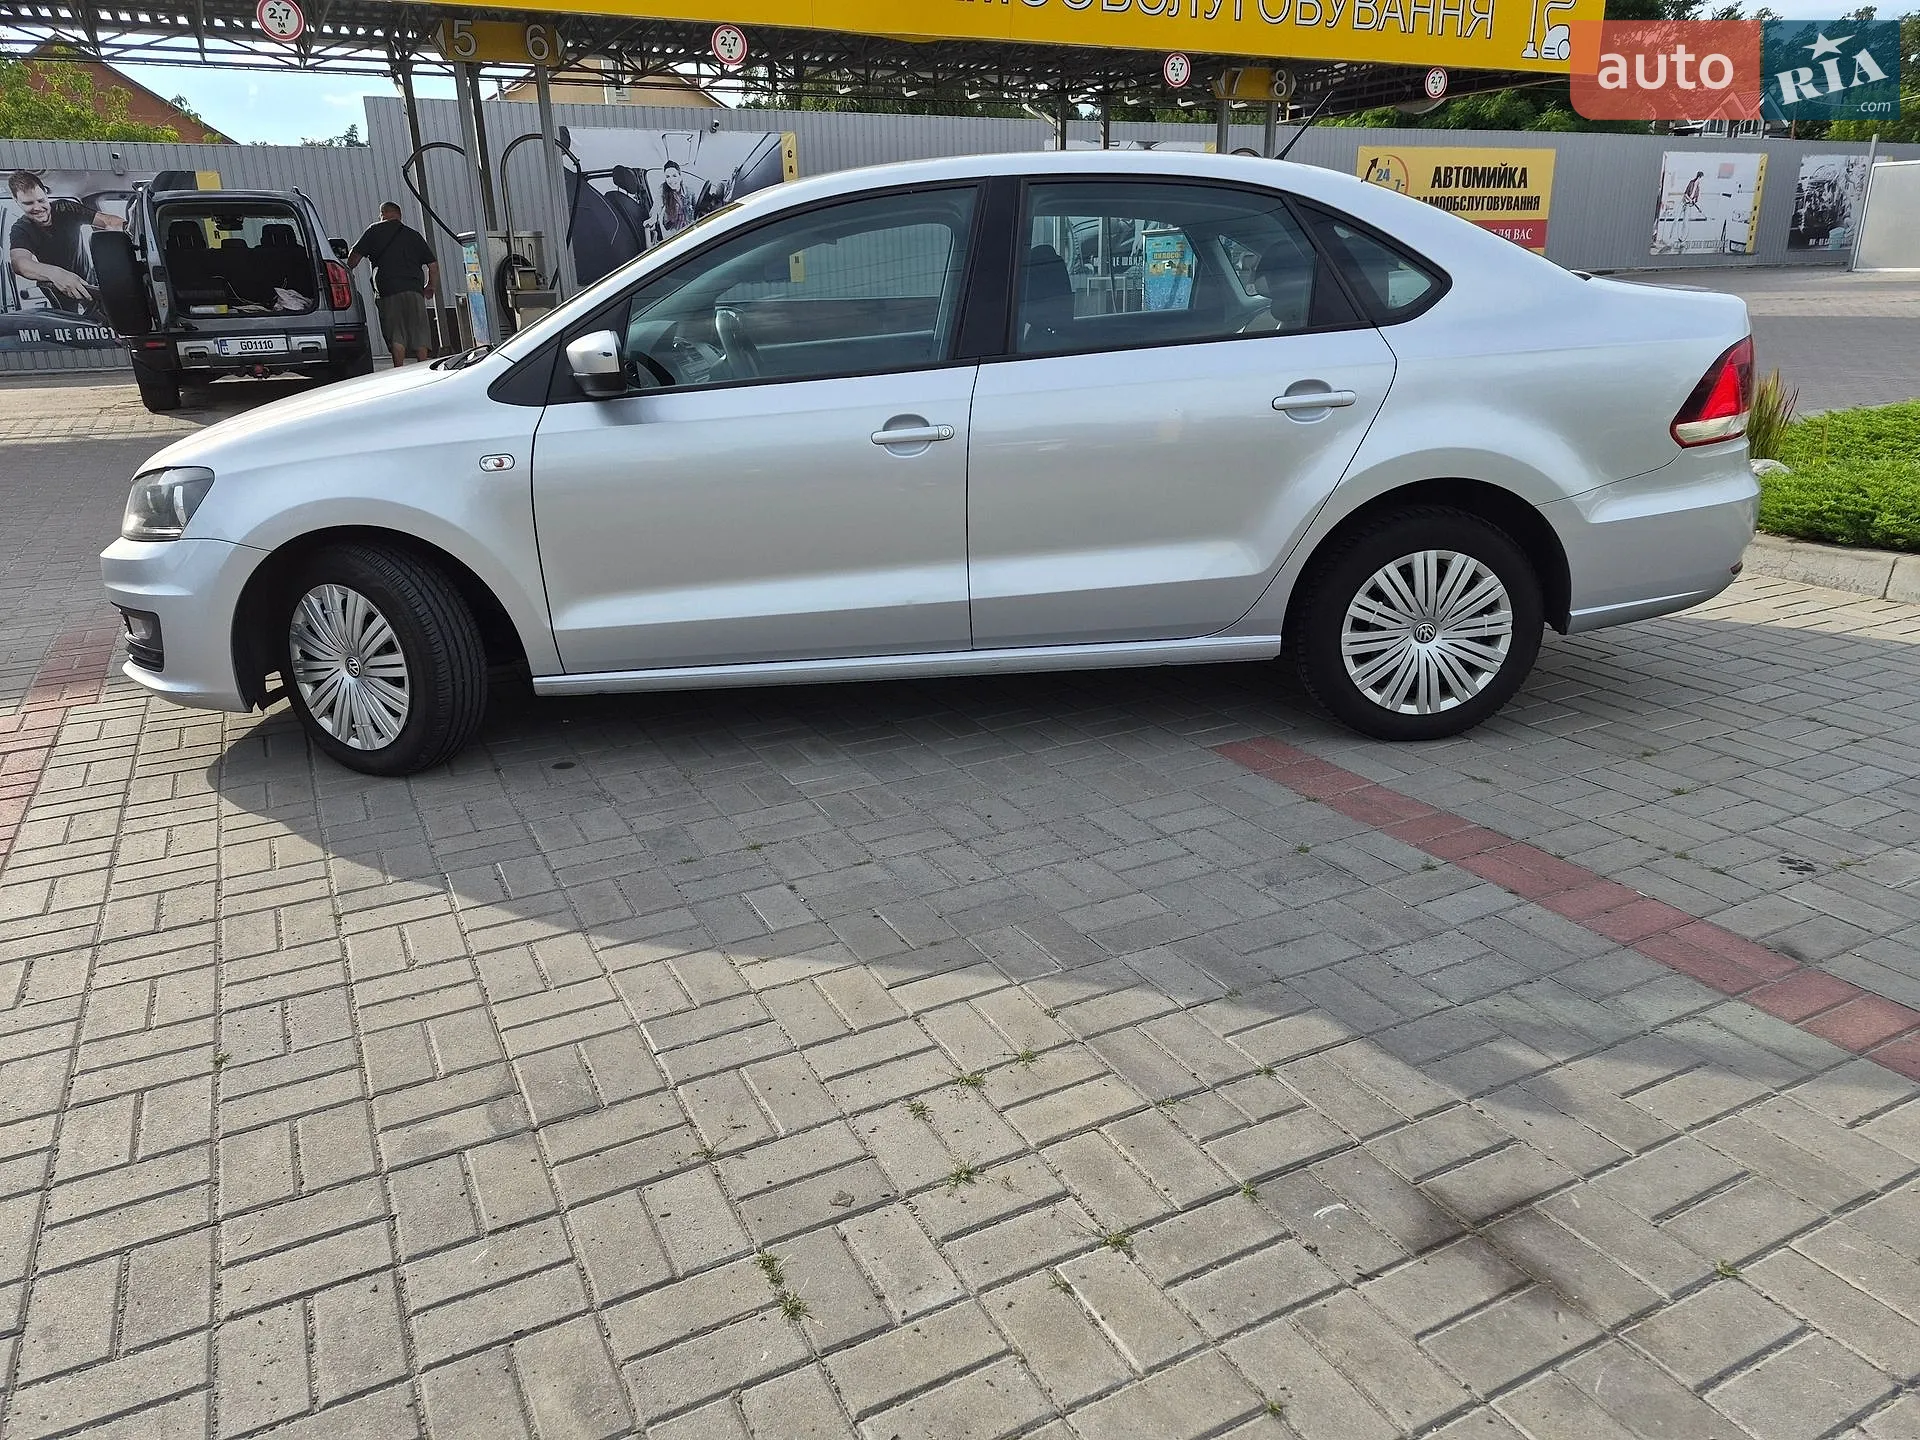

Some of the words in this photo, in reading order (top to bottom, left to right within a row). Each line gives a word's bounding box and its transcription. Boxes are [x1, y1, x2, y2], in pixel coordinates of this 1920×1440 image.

[268, 7, 291, 22] 2,7
[453, 20, 477, 57] 5
[526, 24, 549, 60] 6
[720, 36, 738, 48] 2,7
[1170, 62, 1185, 72] 2,7
[1231, 68, 1244, 95] 7
[1274, 69, 1287, 96] 8
[1375, 168, 1390, 182] 24
[1430, 163, 1528, 188] АВТОМИЙКА
[1416, 195, 1541, 211] МООБСЛУГОВУВАННЯ
[1513, 228, 1533, 240] ВАС
[19, 329, 41, 342] МИ
[54, 328, 73, 342] ЦЕ
[75, 326, 121, 341] ЯКІСТ
